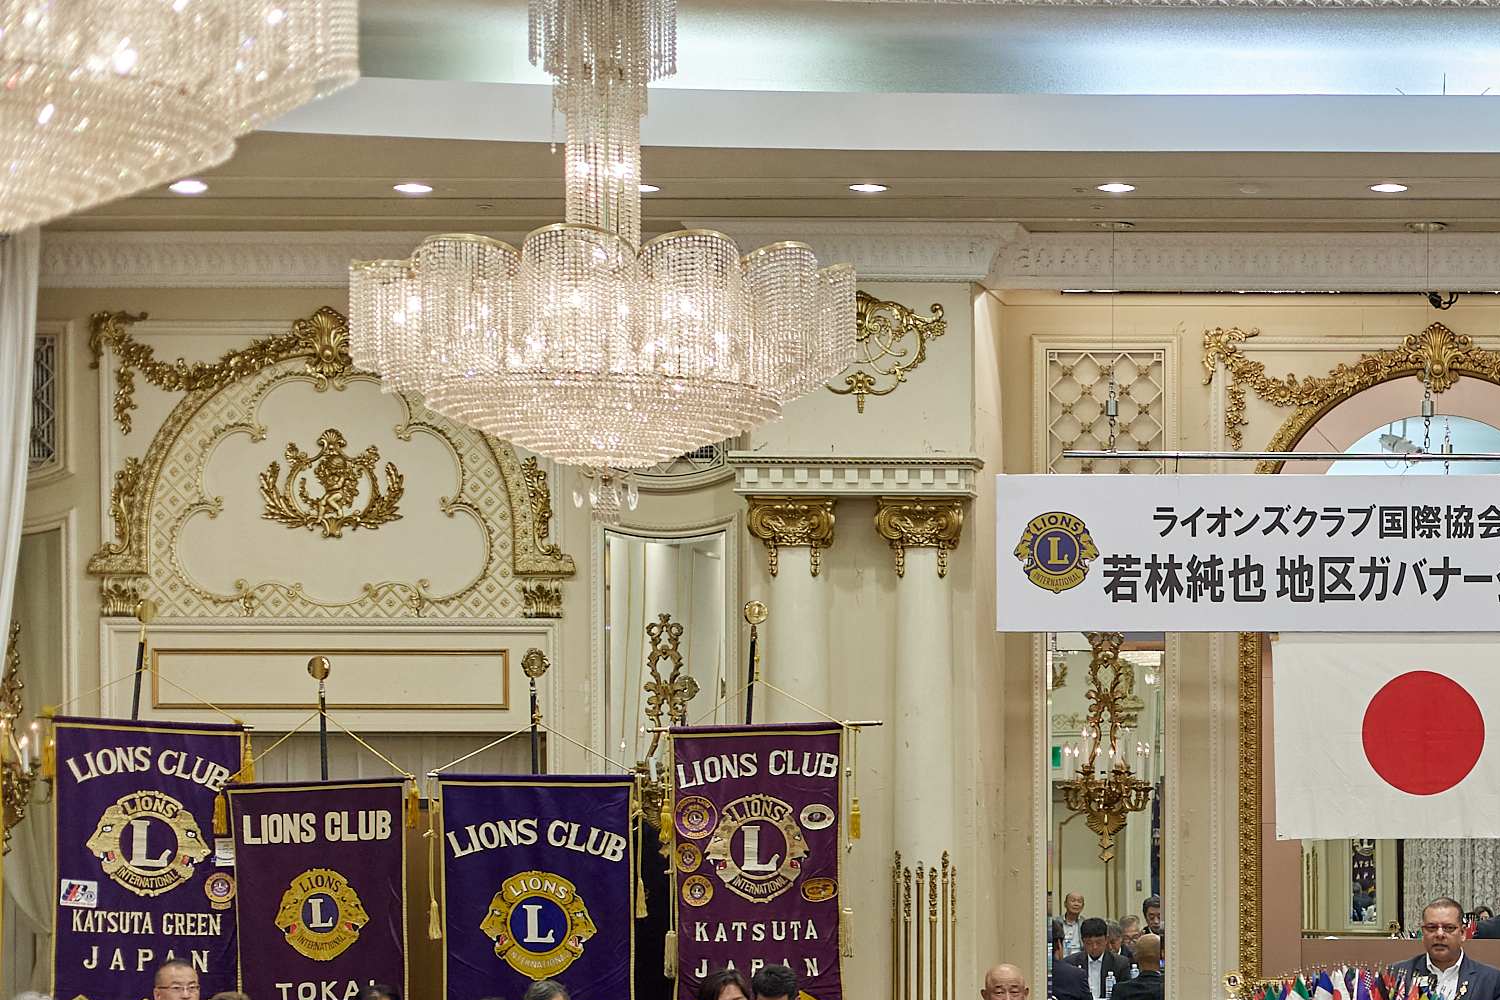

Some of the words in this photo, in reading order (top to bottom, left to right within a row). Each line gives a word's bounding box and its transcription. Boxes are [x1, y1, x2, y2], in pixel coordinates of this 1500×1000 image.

[1032, 514, 1081, 532] LIONS
[1047, 536, 1069, 565] L
[1033, 571, 1081, 587] INTERNATIONAL
[1102, 554, 1267, 603] 若林純也
[66, 746, 152, 784] LIONS
[157, 749, 231, 793] CLUB
[676, 751, 758, 789] LIONS
[768, 749, 839, 778] CLUB
[123, 796, 178, 819] LIONS
[730, 799, 787, 823] LIONS
[242, 812, 317, 845] LIONS
[324, 809, 392, 842] CLUB
[130, 820, 172, 868] L
[446, 818, 539, 858] LIONS
[547, 819, 627, 862] CLUB
[741, 825, 780, 872] L
[117, 866, 180, 889] INTERNATIONAL
[299, 874, 342, 893] LIONS
[508, 877, 568, 900] LIONS
[732, 875, 788, 895] INTERNATIONAL
[72, 909, 155, 934] KATSUTA
[162, 912, 223, 936] GREEN
[307, 898, 333, 928] L
[522, 904, 555, 943] L
[297, 933, 347, 951] INTERNATIONAL
[694, 919, 819, 942] KATSUTA
[508, 949, 572, 970] INTERNATIONAL
